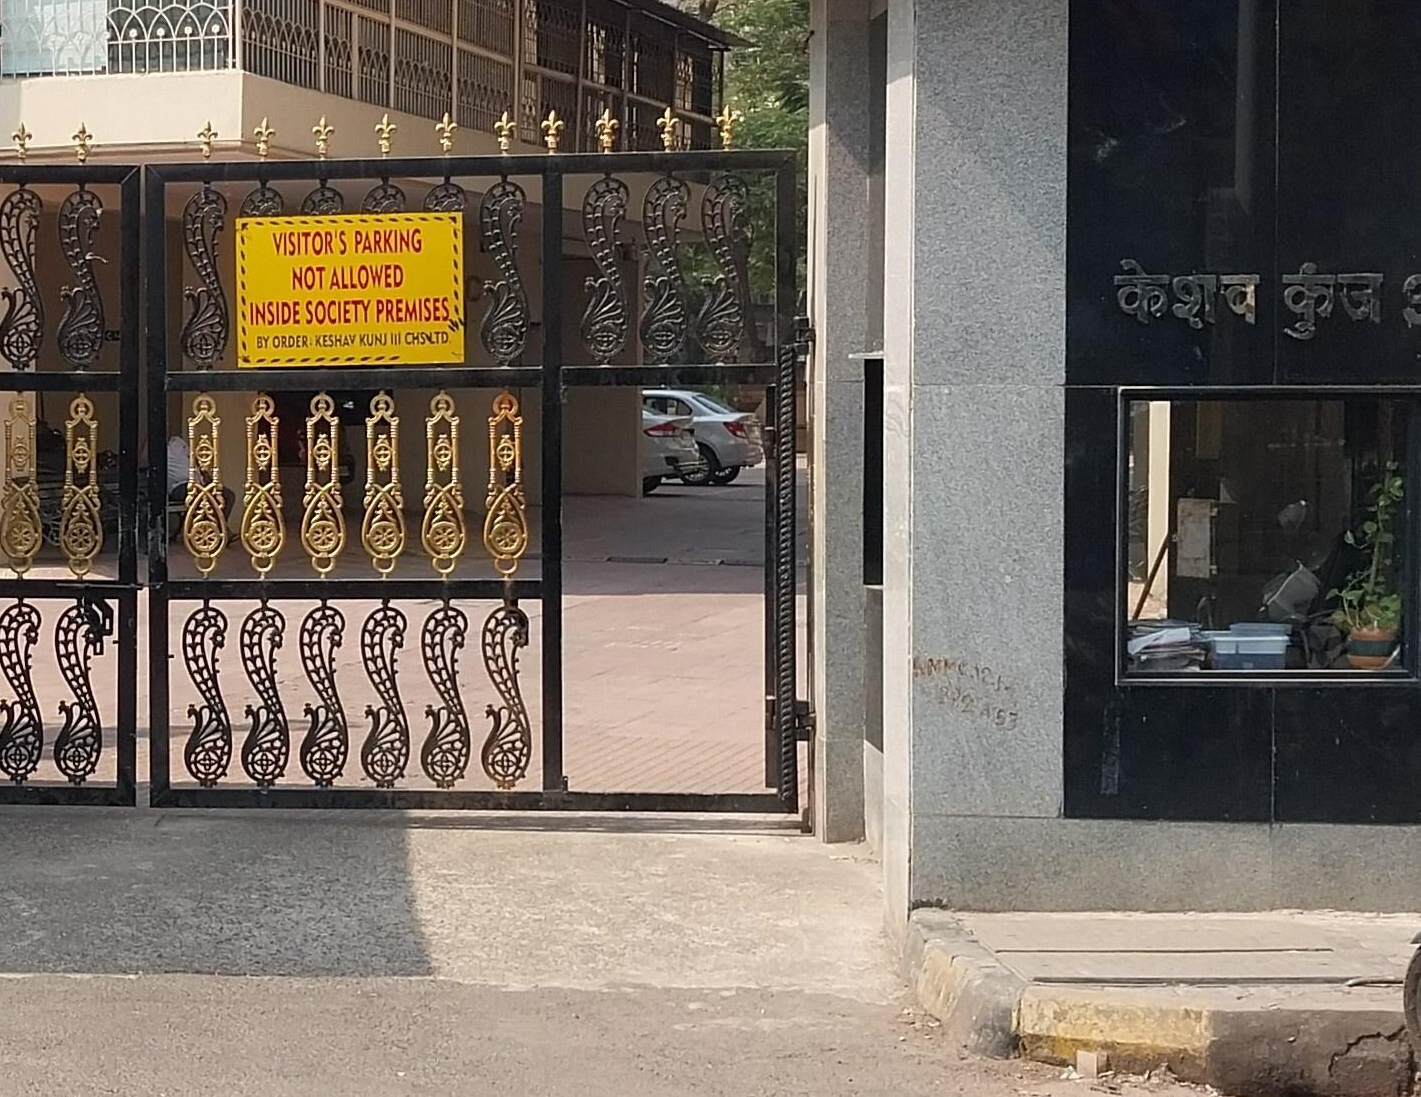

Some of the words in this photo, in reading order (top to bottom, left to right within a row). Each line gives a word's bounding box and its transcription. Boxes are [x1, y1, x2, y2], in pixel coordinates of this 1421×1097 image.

[272, 230, 347, 256] VISITOR'S
[354, 228, 422, 254] PARKING
[292, 265, 326, 291] NOT
[329, 264, 404, 290] ALLOWED
[250, 300, 300, 326] INSIDE
[305, 299, 372, 325] SOCIETY
[375, 297, 451, 323] PREMISES
[256, 336, 270, 349] BY
[315, 333, 356, 348] KESHAV
[359, 332, 388, 347] KUNJ
[390, 332, 402, 345] III
